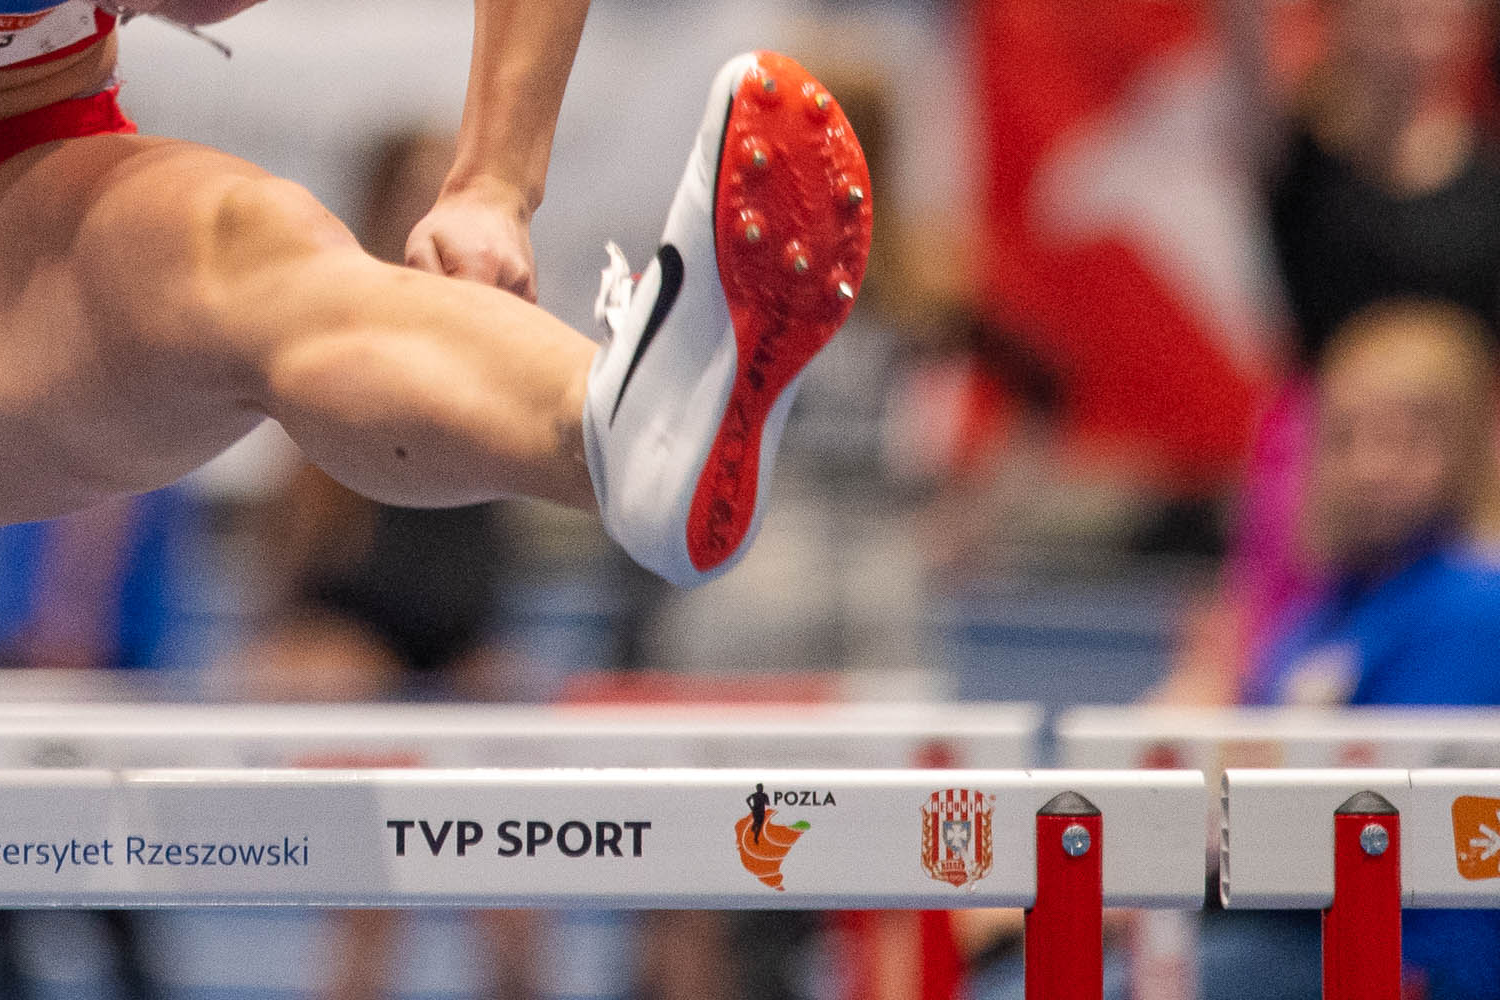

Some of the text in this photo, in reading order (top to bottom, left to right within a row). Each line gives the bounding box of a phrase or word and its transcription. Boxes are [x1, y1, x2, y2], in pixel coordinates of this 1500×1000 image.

[773, 790, 837, 806] POZLA
[126, 835, 309, 866] Rzeszowski
[386, 820, 652, 858] TVP SPORT
